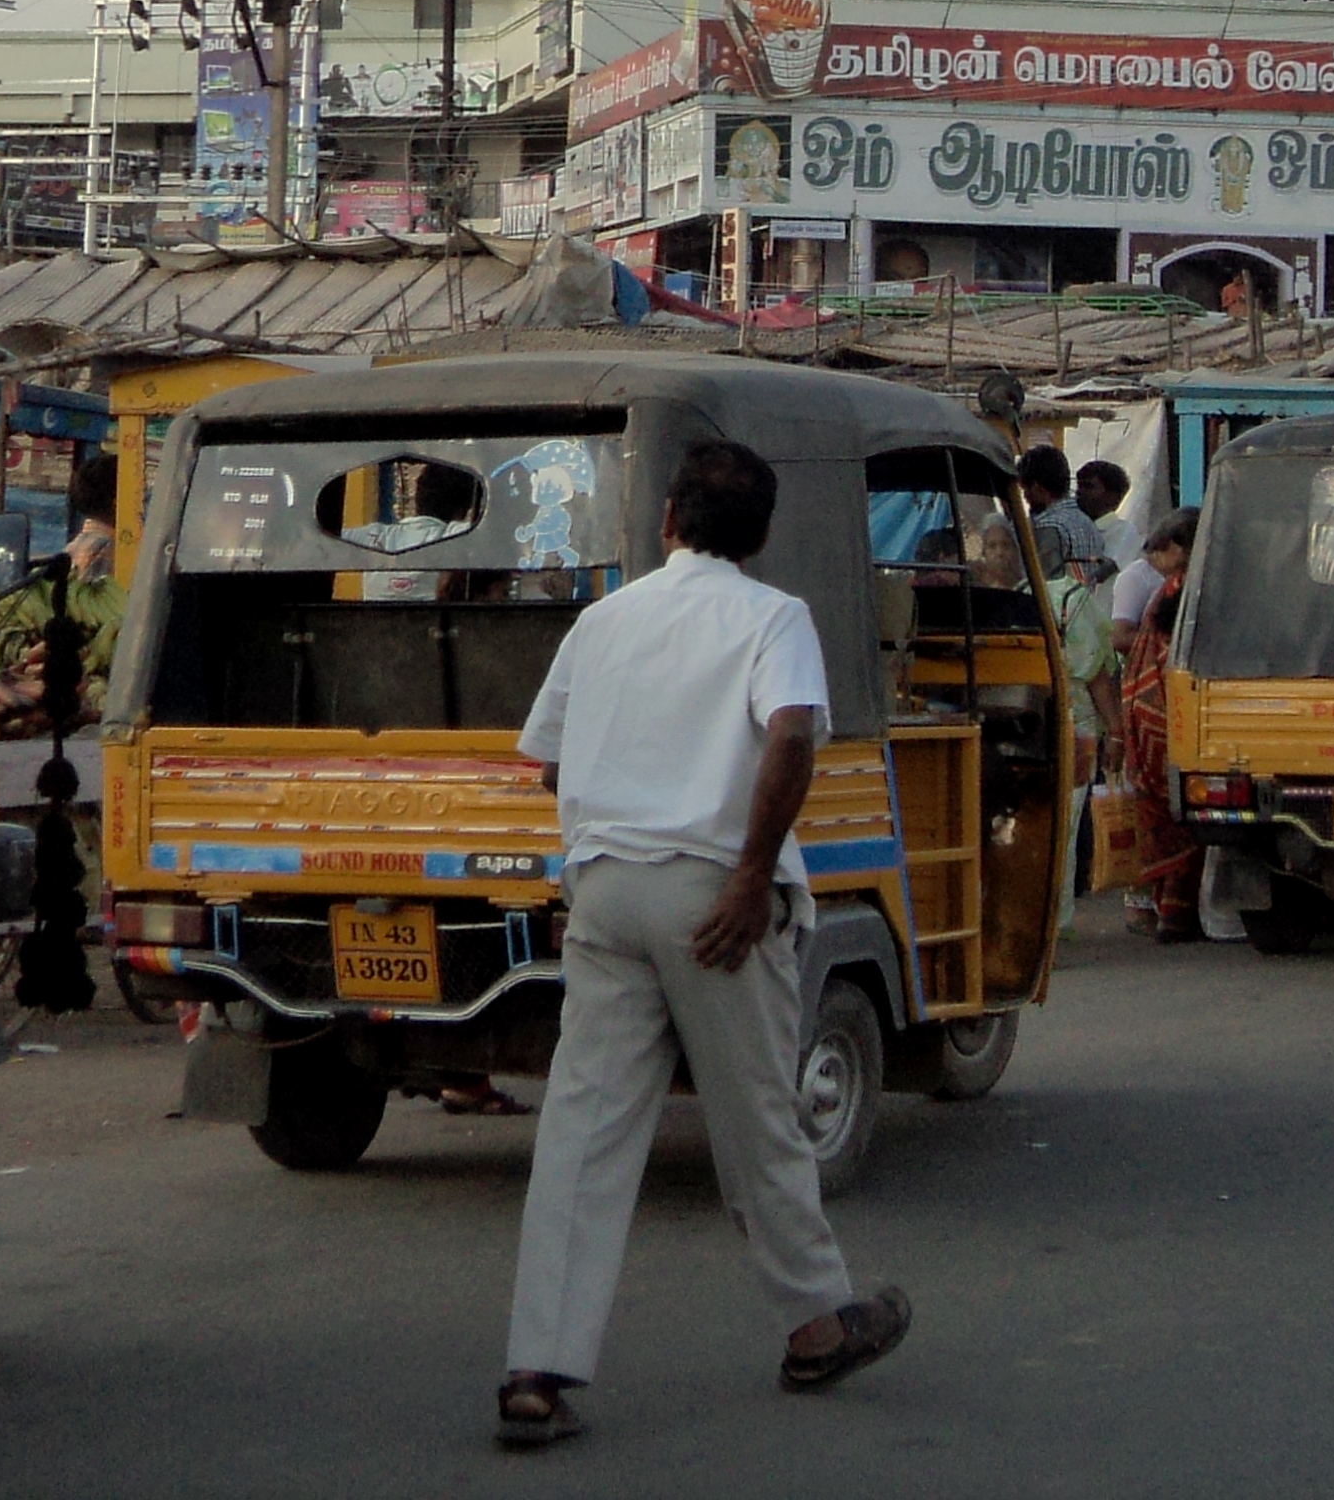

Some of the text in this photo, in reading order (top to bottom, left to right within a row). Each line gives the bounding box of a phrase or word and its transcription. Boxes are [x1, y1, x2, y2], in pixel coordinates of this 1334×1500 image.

[823, 32, 1002, 91] தமிழன்
[1013, 42, 1234, 91] மொபைல்
[289, 789, 452, 817] PIAGGIO
[301, 852, 425, 873] SOUND HORN
[476, 854, 533, 874] ape
[385, 925, 416, 945] 43
